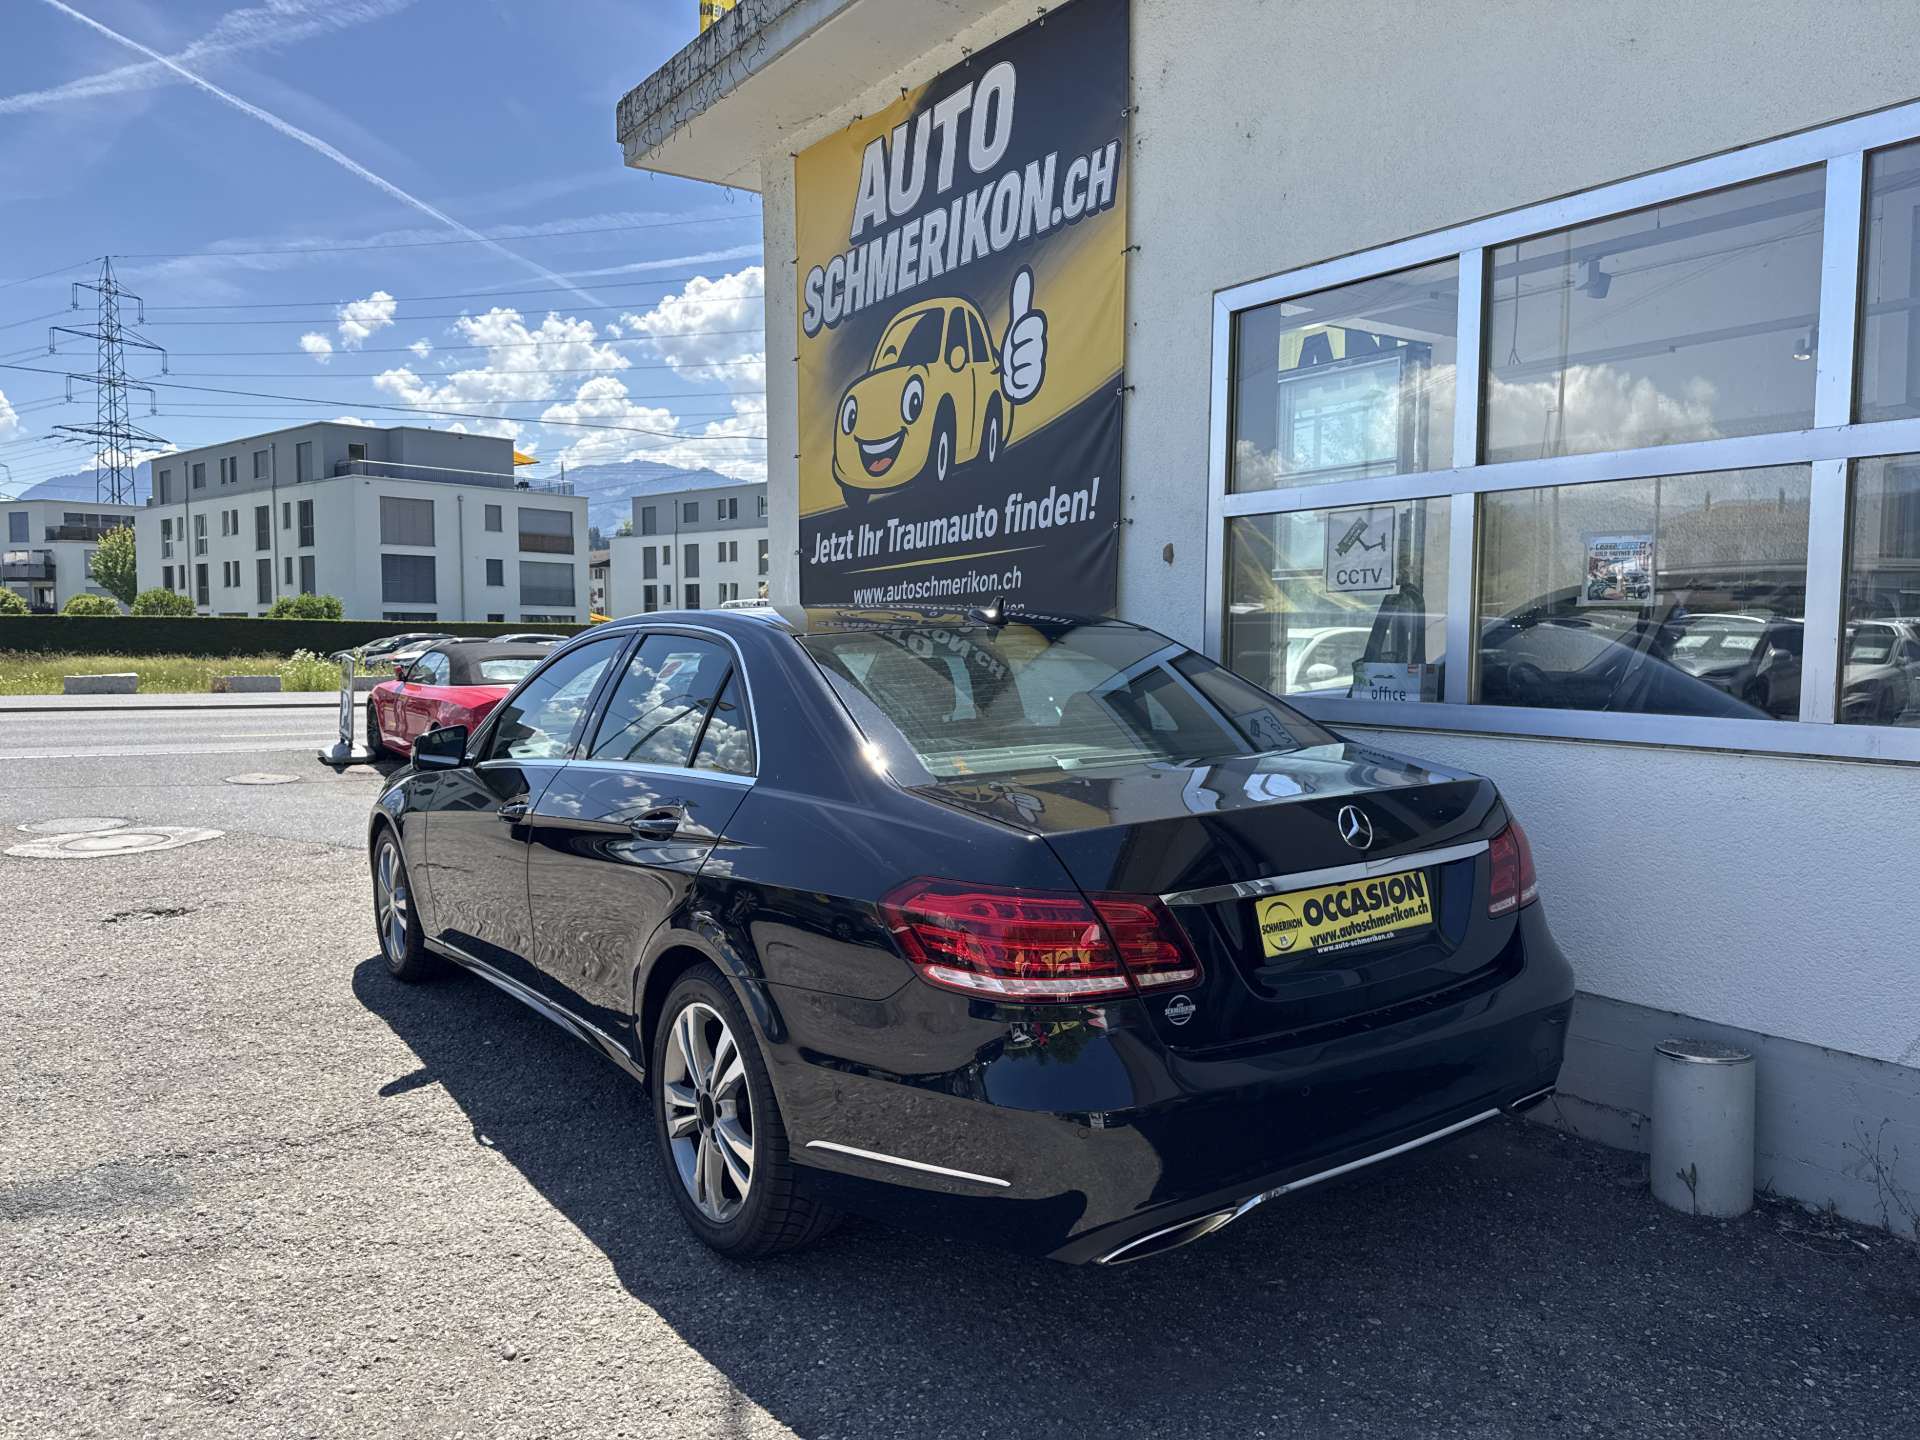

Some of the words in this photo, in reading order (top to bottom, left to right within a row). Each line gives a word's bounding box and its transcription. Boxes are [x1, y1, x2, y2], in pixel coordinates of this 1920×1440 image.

[850, 61, 1016, 239] AUTO
[803, 141, 1118, 333] SCHMERIKON.CH
[810, 532, 853, 565] Jetzt
[857, 523, 883, 557] Ihr
[887, 504, 997, 553] Traumauto
[1004, 477, 1100, 535] finden!
[853, 566, 1022, 604] www.autoschmerikon.ch
[1336, 568, 1382, 585] CCTV
[1371, 686, 1406, 701] office
[1303, 873, 1425, 926] OCCASION
[1261, 917, 1303, 935] SCHMERIKON
[1310, 900, 1429, 947] www.autoschmerikon.ch
[1317, 932, 1395, 954] www.auto-schmerikon.ch
